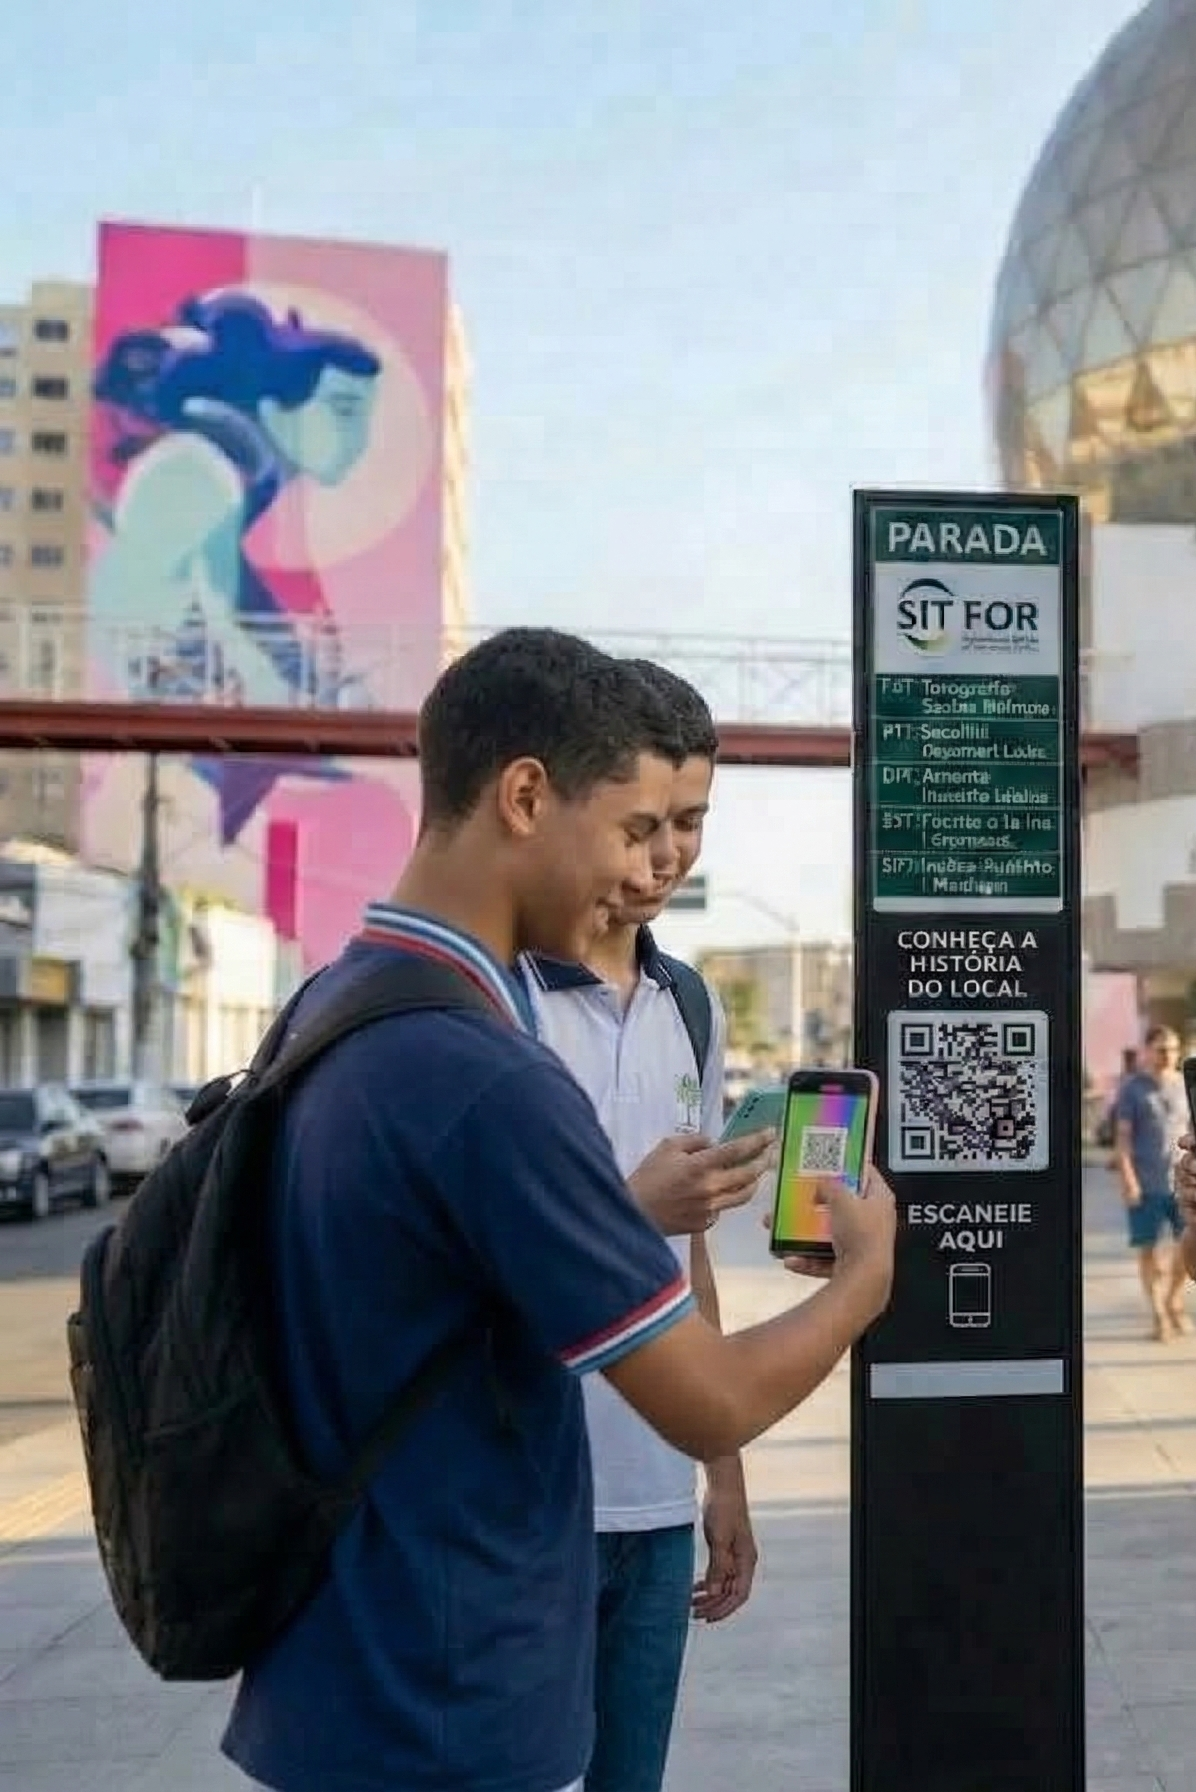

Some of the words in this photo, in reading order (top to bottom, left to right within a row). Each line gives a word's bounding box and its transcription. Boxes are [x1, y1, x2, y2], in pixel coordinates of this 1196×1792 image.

[888, 521, 1048, 556] PARADA
[897, 599, 953, 631] SIT
[964, 599, 1038, 631] FOR
[898, 930, 1016, 953] CONHEÇA
[1020, 931, 1038, 949] A
[911, 949, 1022, 972] HISTÓRIA
[908, 979, 942, 998] DO
[951, 979, 1028, 998] LOCAL
[908, 1204, 1032, 1224] ESCANEIE
[939, 1231, 1004, 1252] AQUI
